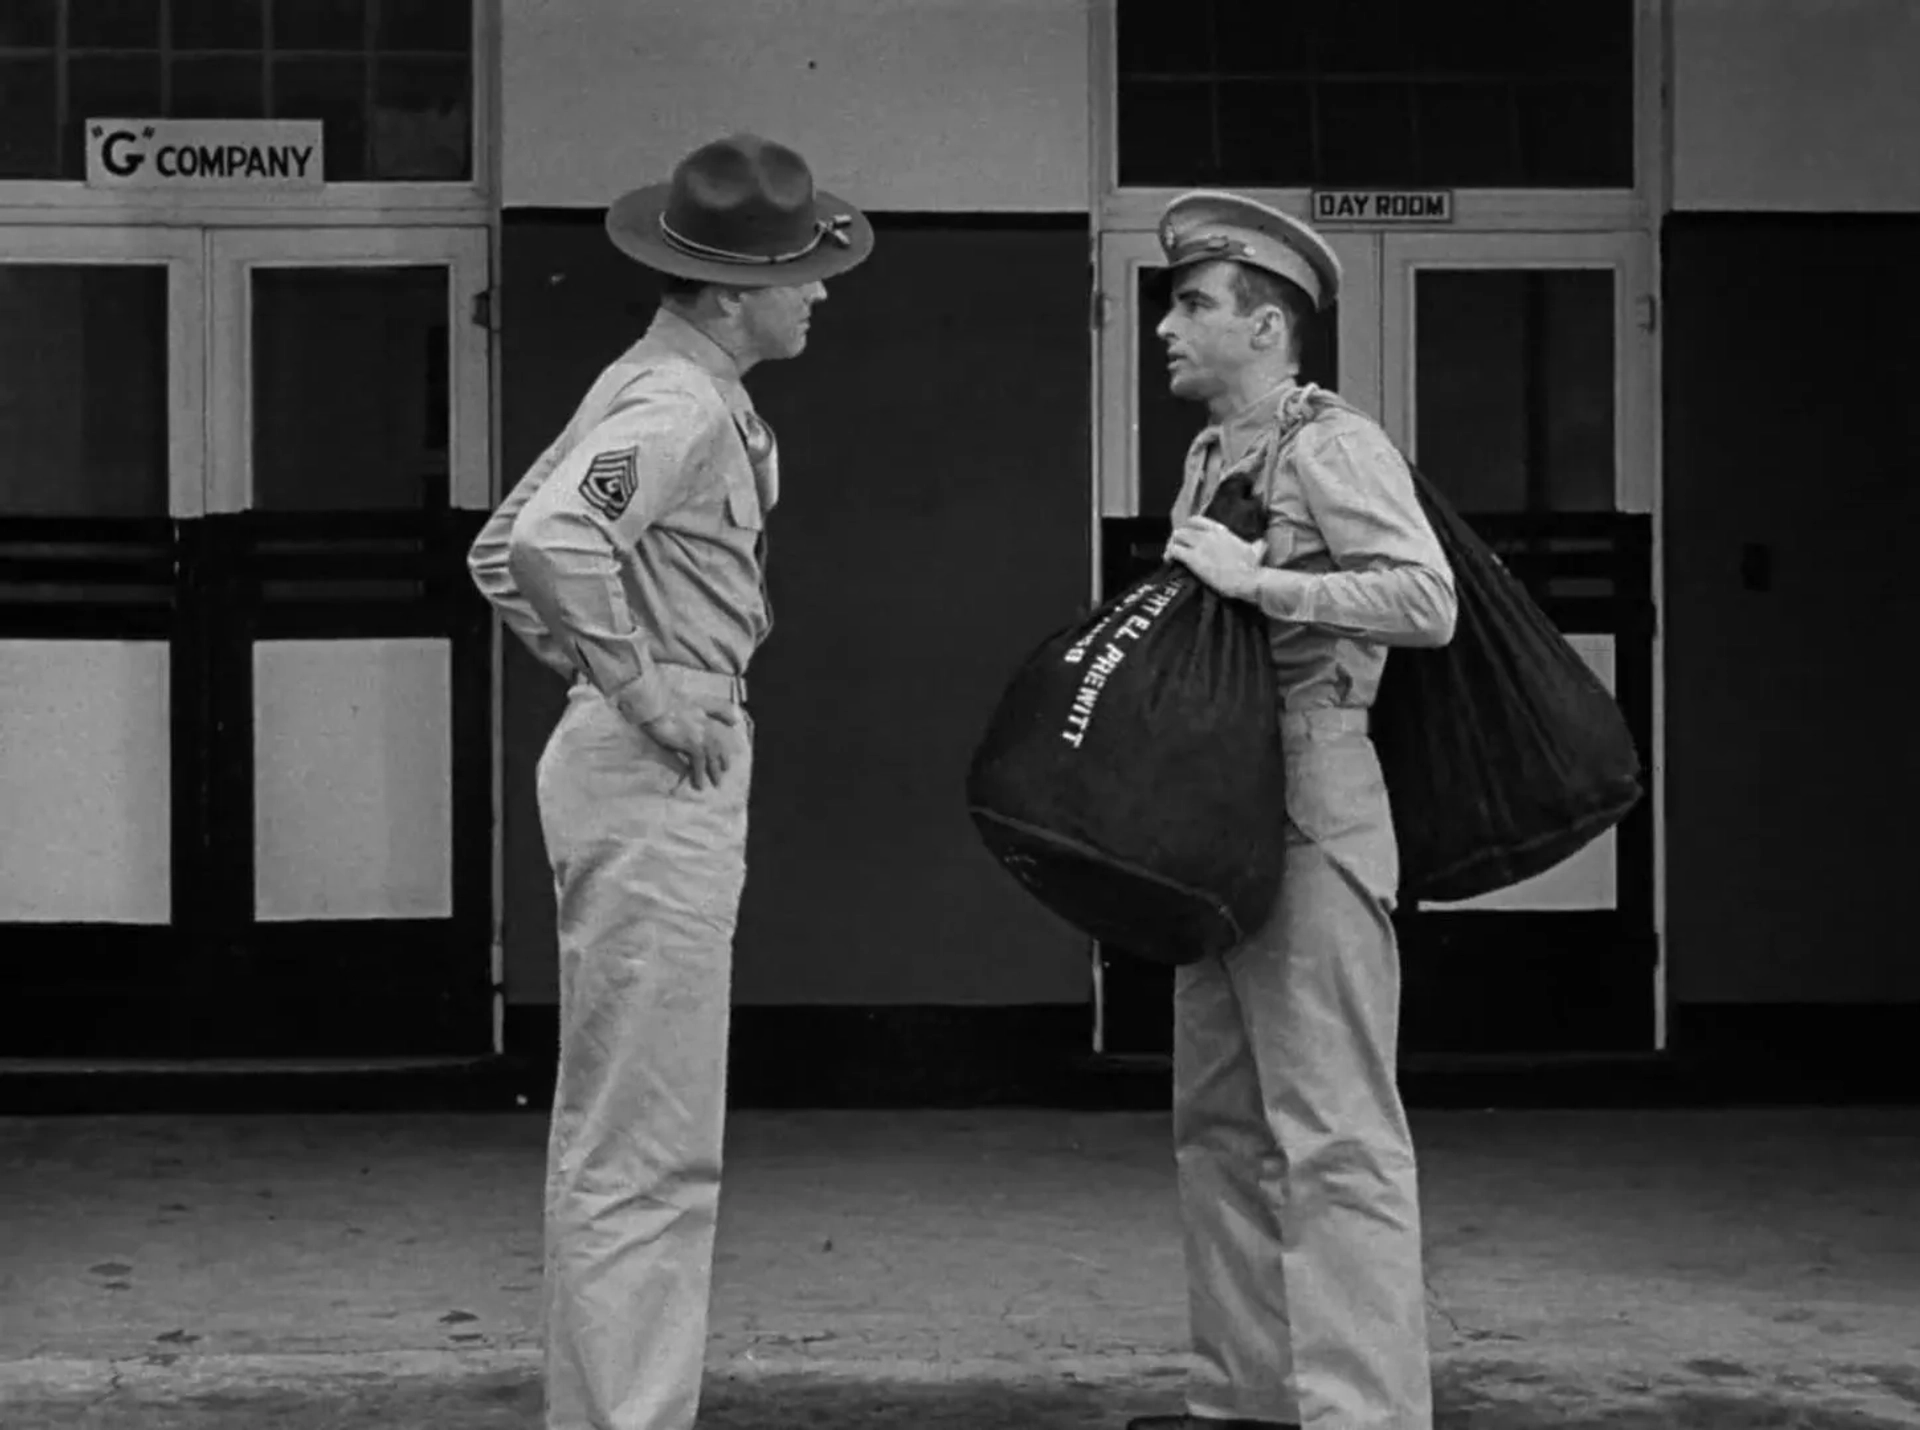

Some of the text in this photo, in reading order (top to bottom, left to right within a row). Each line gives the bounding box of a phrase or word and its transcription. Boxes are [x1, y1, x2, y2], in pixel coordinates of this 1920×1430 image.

[91, 125, 313, 178] "G" COMPANY
[1320, 194, 1444, 216] DAY ROOM
[1061, 641, 1126, 749] PREWITT
